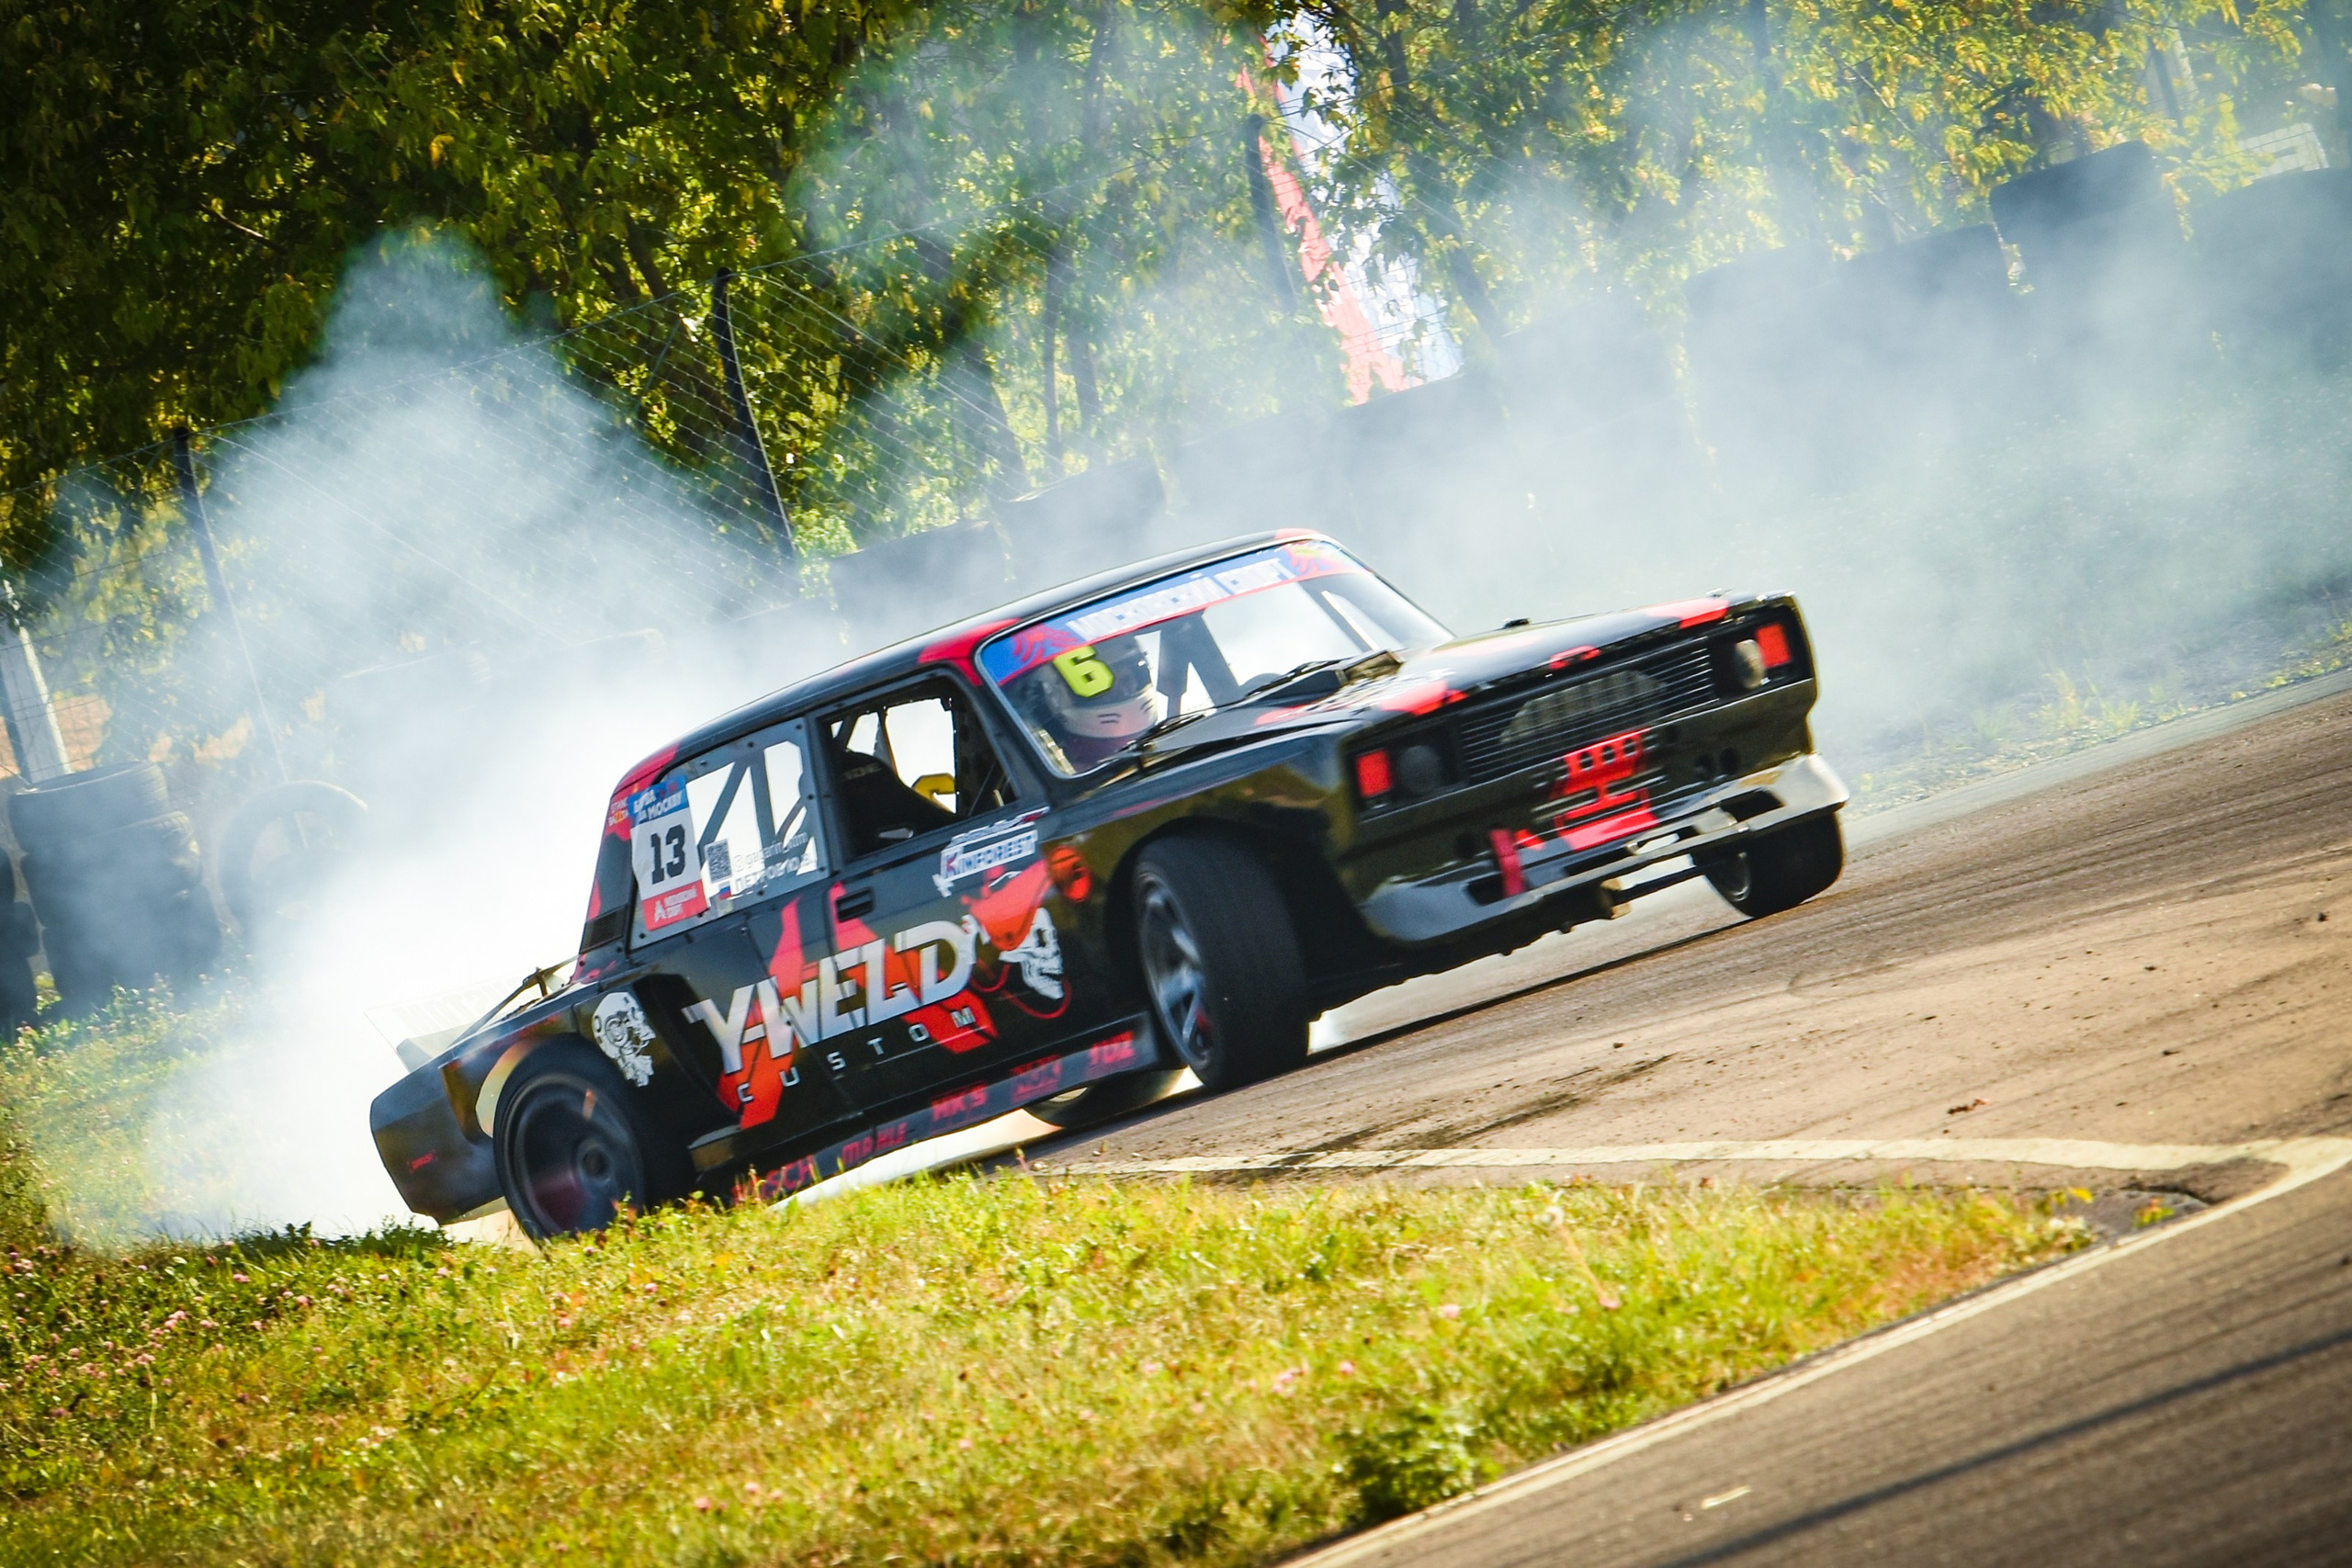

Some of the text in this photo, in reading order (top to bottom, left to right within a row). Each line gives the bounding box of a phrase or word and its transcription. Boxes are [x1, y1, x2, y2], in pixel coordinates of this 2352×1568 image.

[1053, 645, 1114, 698] 6
[650, 824, 685, 886] 13
[737, 1007, 977, 1102] CUSTOM
